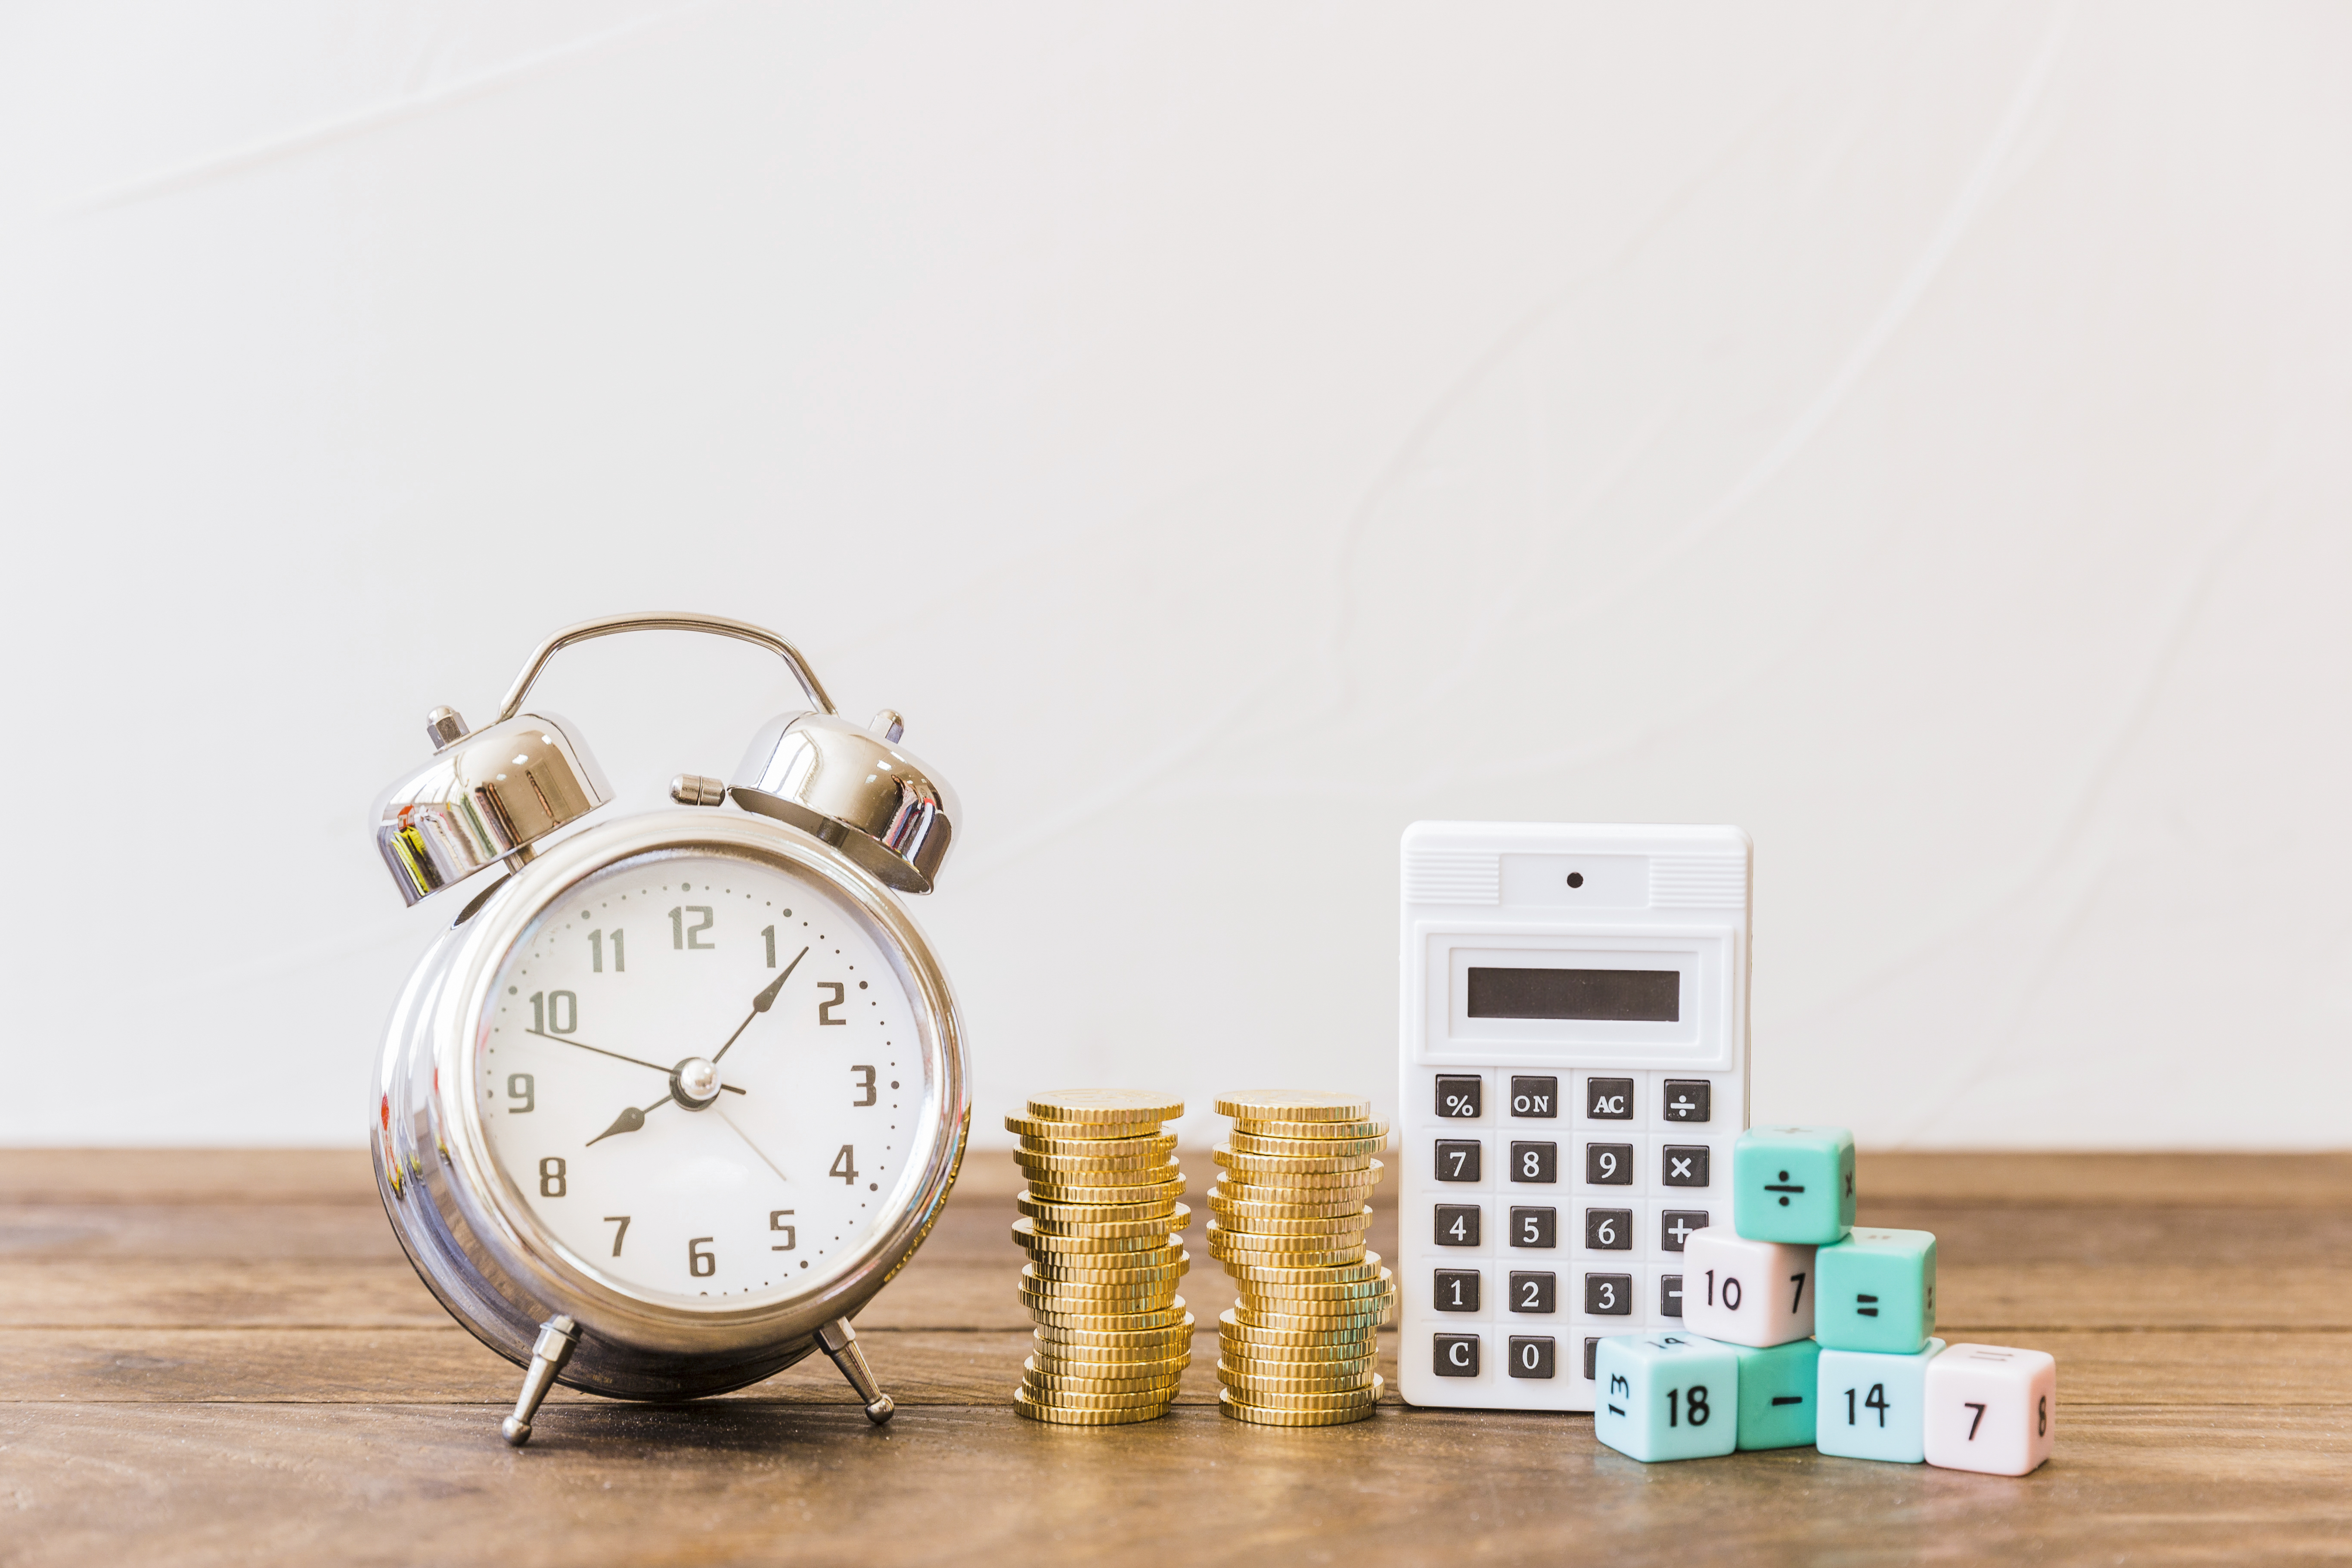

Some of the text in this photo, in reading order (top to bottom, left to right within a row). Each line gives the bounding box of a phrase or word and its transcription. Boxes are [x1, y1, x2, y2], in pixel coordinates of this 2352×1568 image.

[668, 906, 714, 949] 12
[761, 925, 776, 968] 1
[588, 928, 624, 972] 11
[530, 990, 577, 1034] 10
[817, 982, 846, 1025] 2
[508, 1074, 534, 1114] 9
[851, 1065, 876, 1106] 3
[1514, 1096, 1548, 1112] ON
[1594, 1096, 1623, 1113] AC
[540, 1158, 566, 1197] 8
[829, 1145, 858, 1185] 4
[1450, 1152, 1466, 1177] 7
[1524, 1152, 1539, 1177] 8
[1600, 1153, 1616, 1178] 9
[604, 1217, 630, 1257] 7
[770, 1210, 795, 1251] 5
[1449, 1216, 1466, 1241] 4
[1524, 1217, 1539, 1242] 5
[1599, 1219, 1615, 1244] 6
[689, 1237, 715, 1277] 6
[1451, 1280, 1462, 1304] 1
[1522, 1282, 1539, 1307] 2
[1599, 1283, 1615, 1308] 3
[1706, 1270, 1741, 1310] 10
[1791, 1273, 1806, 1314] 7
[1449, 1342, 1468, 1366] C
[1608, 1374, 1629, 1416] 13
[1667, 1385, 1710, 1427] 18
[1845, 1384, 1890, 1427] 14
[1964, 1403, 1986, 1441] 7
